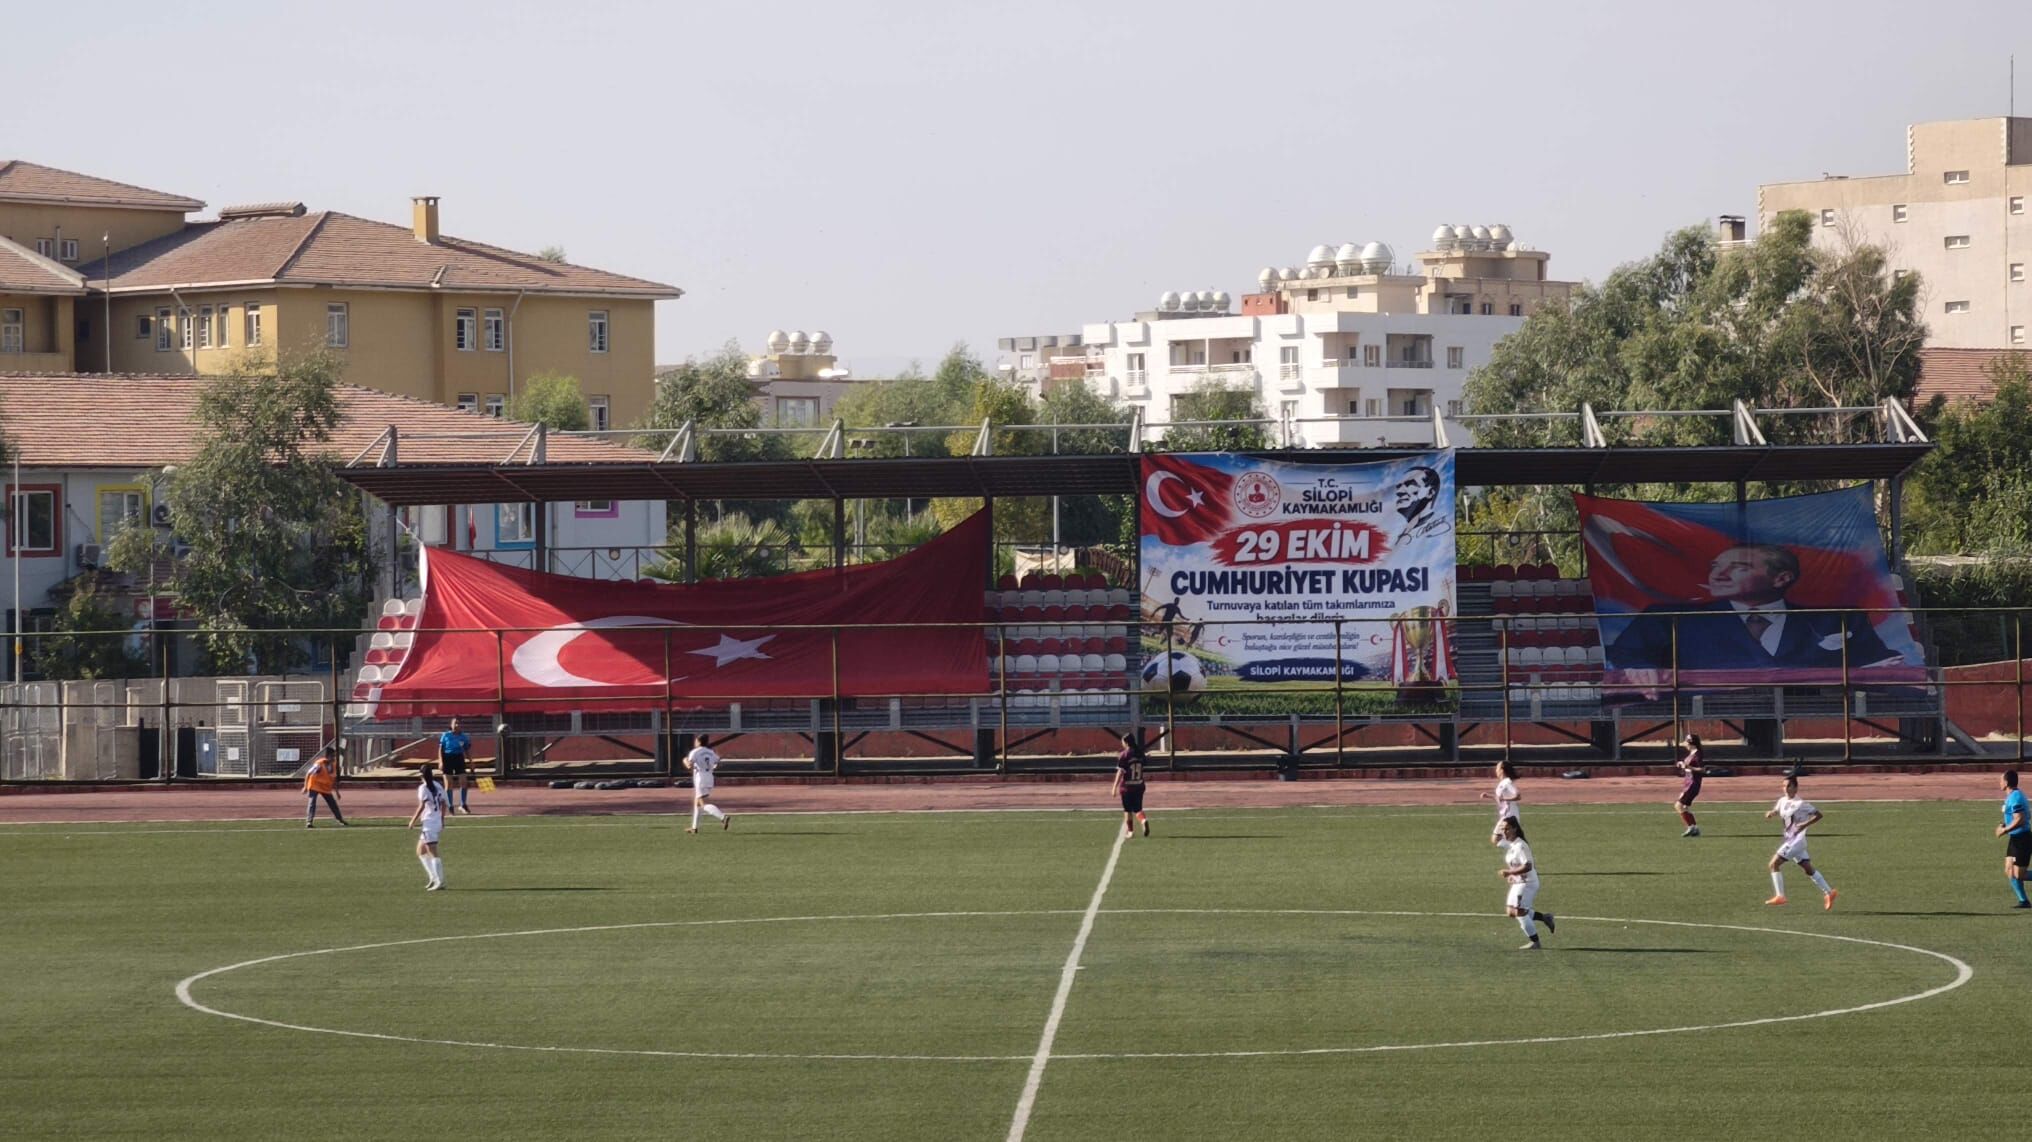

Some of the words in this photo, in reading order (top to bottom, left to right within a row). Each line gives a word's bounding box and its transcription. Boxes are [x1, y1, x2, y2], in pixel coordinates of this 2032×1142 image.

[1318, 479, 1339, 488] T.C.
[1302, 487, 1353, 502] SİLOPİ
[1282, 501, 1383, 515] KAYMAKAMLIĞI
[1233, 530, 1280, 562] 29
[1287, 521, 1370, 561] EKİM
[1170, 565, 1336, 595] CUMHURİYET
[1342, 567, 1429, 594] KUPASI
[1207, 600, 1261, 613] Turnuvaya
[1264, 600, 1300, 610] katılan
[1302, 600, 1323, 610] tüm
[1325, 599, 1396, 610] takımlarımıza
[1250, 665, 1281, 676] SİLOPİ
[1283, 664, 1354, 676] KAYMAKAMIĞI
